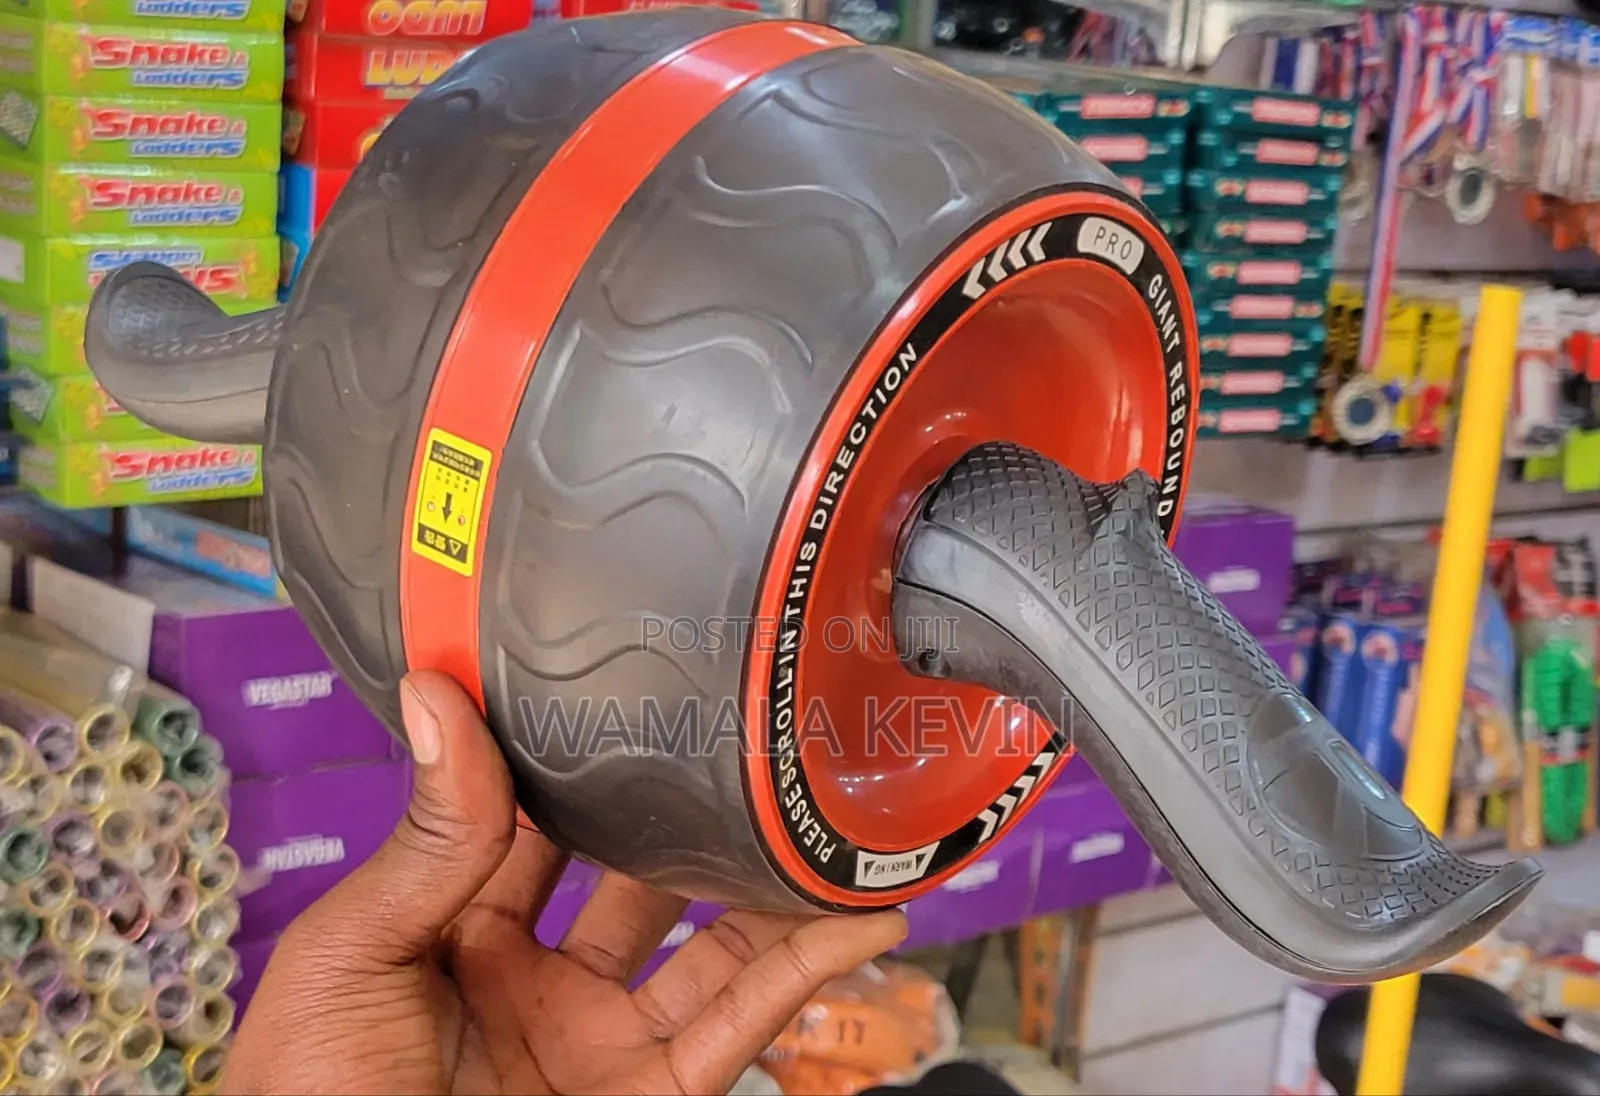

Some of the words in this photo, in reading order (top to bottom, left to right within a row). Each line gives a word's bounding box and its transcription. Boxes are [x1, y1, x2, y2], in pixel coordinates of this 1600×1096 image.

[90, 38, 230, 68] Snake
[364, 49, 453, 86] LUD
[133, 69, 247, 88] Ladders
[90, 109, 229, 139] Snake
[131, 140, 245, 158] Ladders
[90, 180, 226, 209] Snake
[131, 207, 242, 226] Ladders
[1094, 226, 1132, 260] PRO
[1148, 273, 1181, 353] GIANT
[810, 342, 918, 531] DIRECTION
[1156, 361, 1186, 518] REBOUND
[109, 448, 236, 479] Snake
[784, 541, 816, 623] THIS
[785, 783, 837, 863] PLEASE
[874, 859, 913, 876] WARNING
